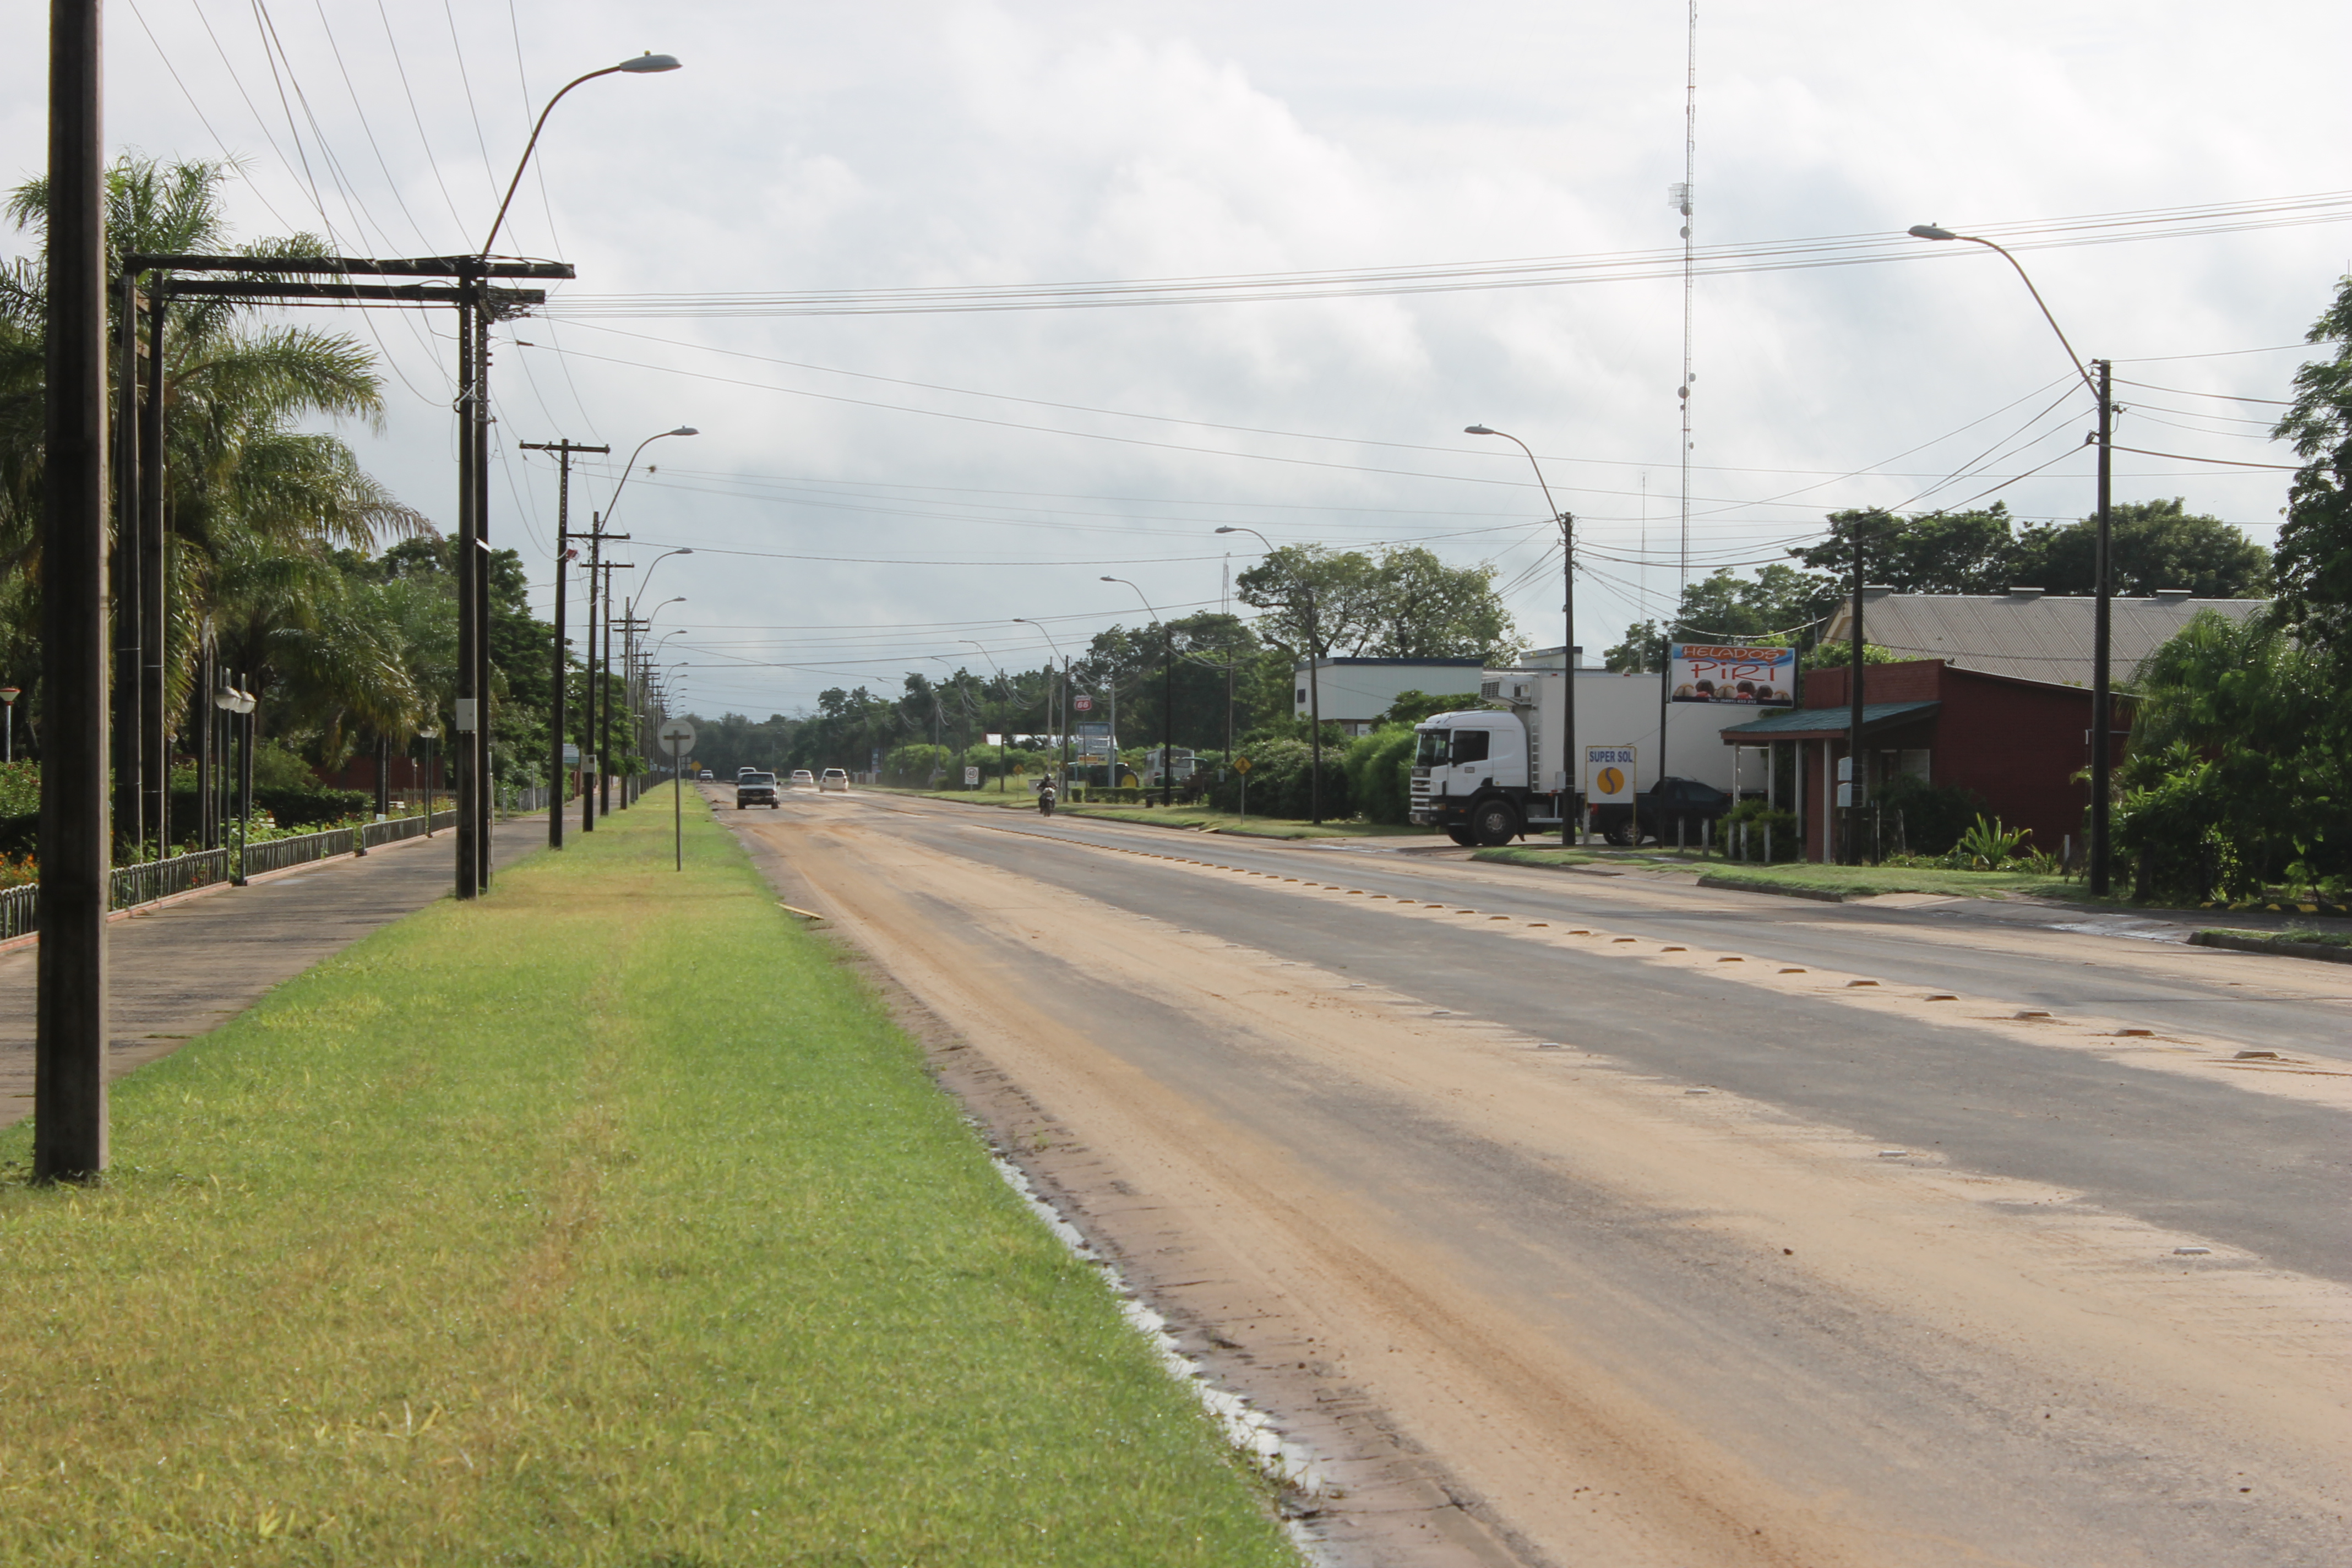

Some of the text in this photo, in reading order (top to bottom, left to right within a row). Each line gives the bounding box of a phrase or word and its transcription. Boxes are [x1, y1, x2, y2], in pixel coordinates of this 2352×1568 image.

[1684, 647, 1779, 659] HELADOS
[1589, 751, 1632, 762] SUPER SOL
